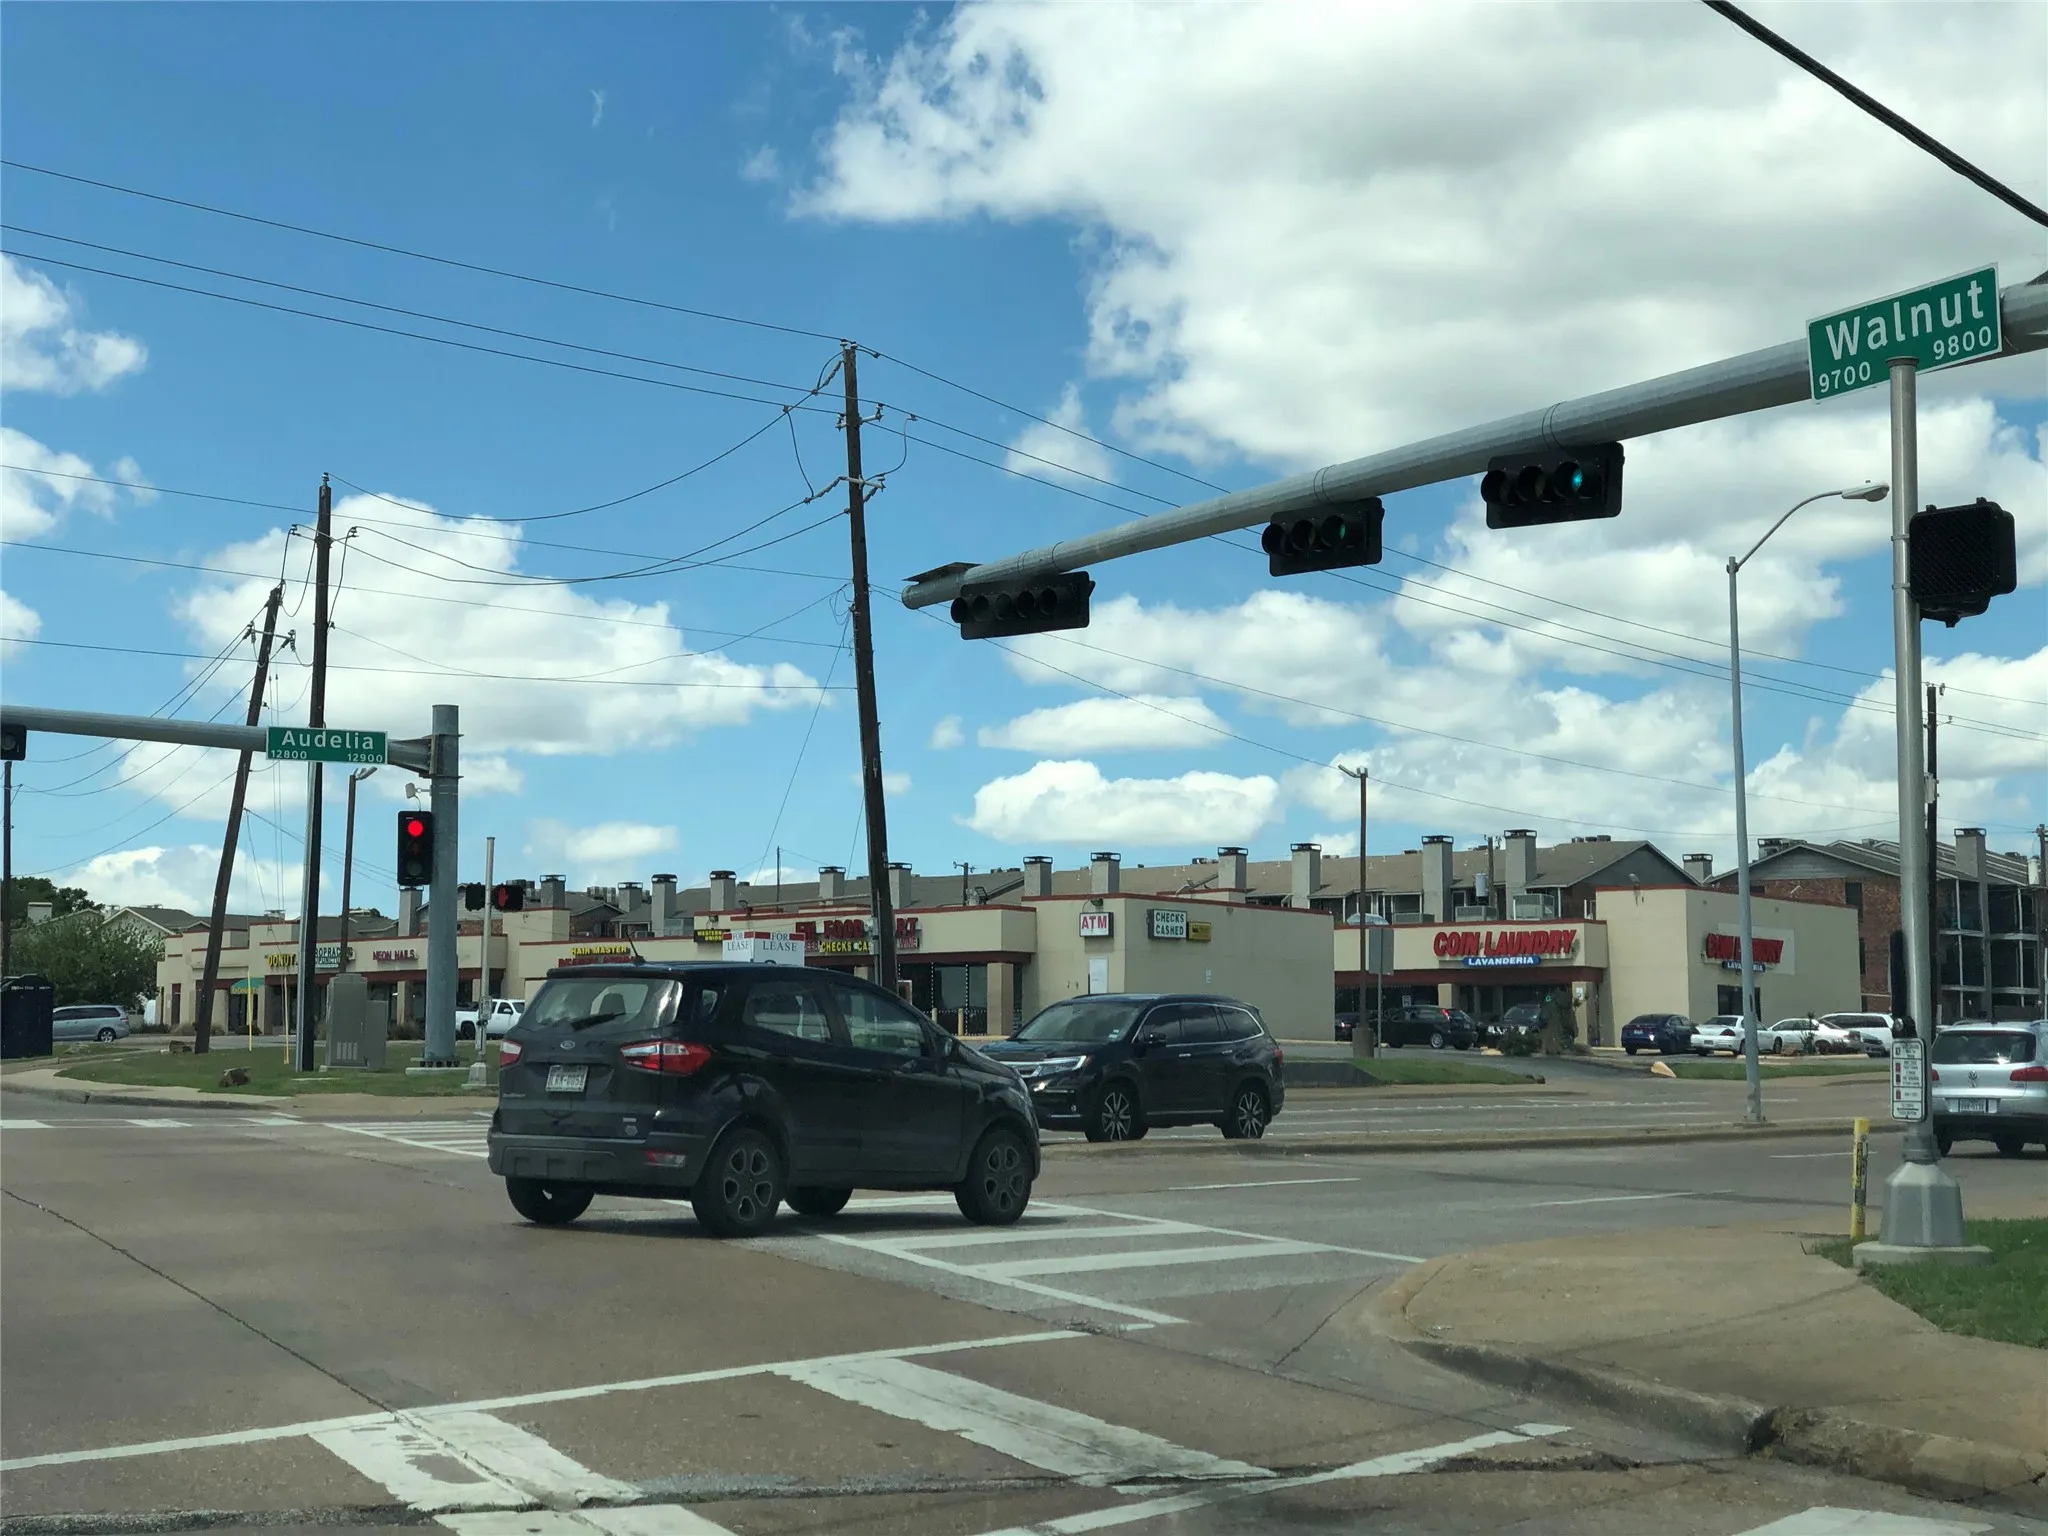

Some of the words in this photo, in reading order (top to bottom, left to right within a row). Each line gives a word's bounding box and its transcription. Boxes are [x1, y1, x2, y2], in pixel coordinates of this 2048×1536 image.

[1825, 280, 1984, 361] Walnut
[1818, 361, 1871, 393] 9700
[1933, 326, 1992, 360] 9800
[281, 730, 374, 750] Audelia
[271, 750, 308, 760] 12800
[347, 753, 383, 763] 12900
[1081, 915, 1107, 930] ATM
[1155, 912, 1185, 923] CHECKS
[732, 932, 744, 940] FOR
[1155, 925, 1184, 936] CASHED
[771, 932, 789, 941] FOR
[727, 941, 750, 951] LEASE
[763, 941, 797, 952] LEASE
[821, 940, 852, 952] CHECKS
[1433, 931, 1481, 957] COIN
[1483, 929, 1577, 957] LAUNDRY
[373, 950, 391, 961] NEON
[394, 949, 416, 961] NAILS
[571, 946, 591, 956] HAIR
[593, 945, 628, 955] MASTER
[1468, 956, 1534, 966] LAVANDERIA
